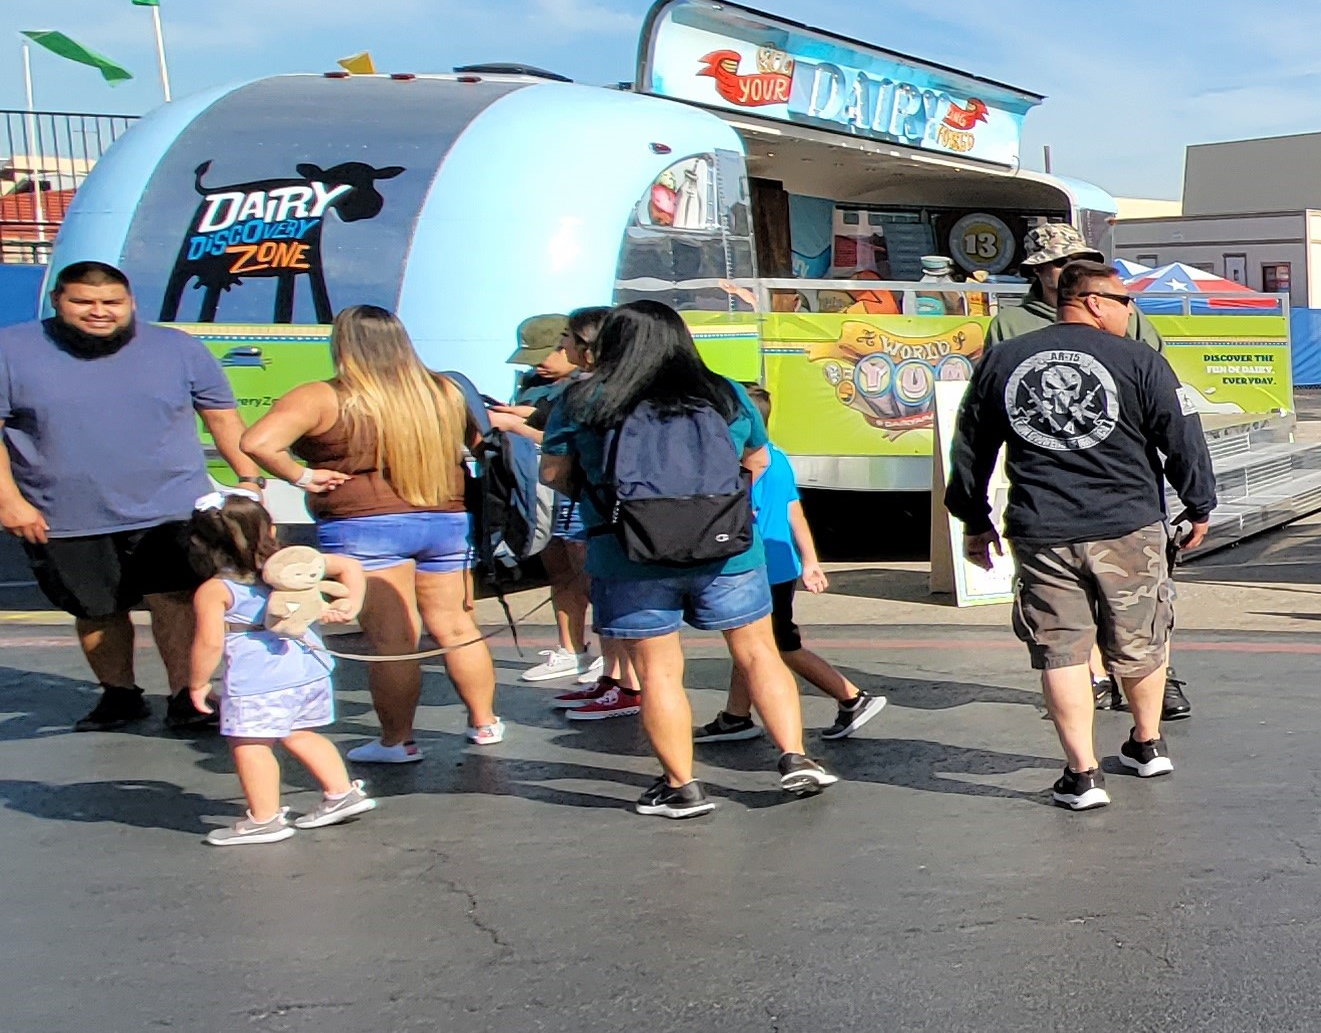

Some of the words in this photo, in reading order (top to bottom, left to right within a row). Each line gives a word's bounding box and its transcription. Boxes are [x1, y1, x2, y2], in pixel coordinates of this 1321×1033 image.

[738, 78, 789, 103] YOUR
[226, 242, 311, 274] ZONE
[964, 233, 997, 258] 13
[879, 335, 951, 360] WORLD
[1050, 352, 1080, 362] AR-15
[1203, 354, 1252, 362] DISCOVER
